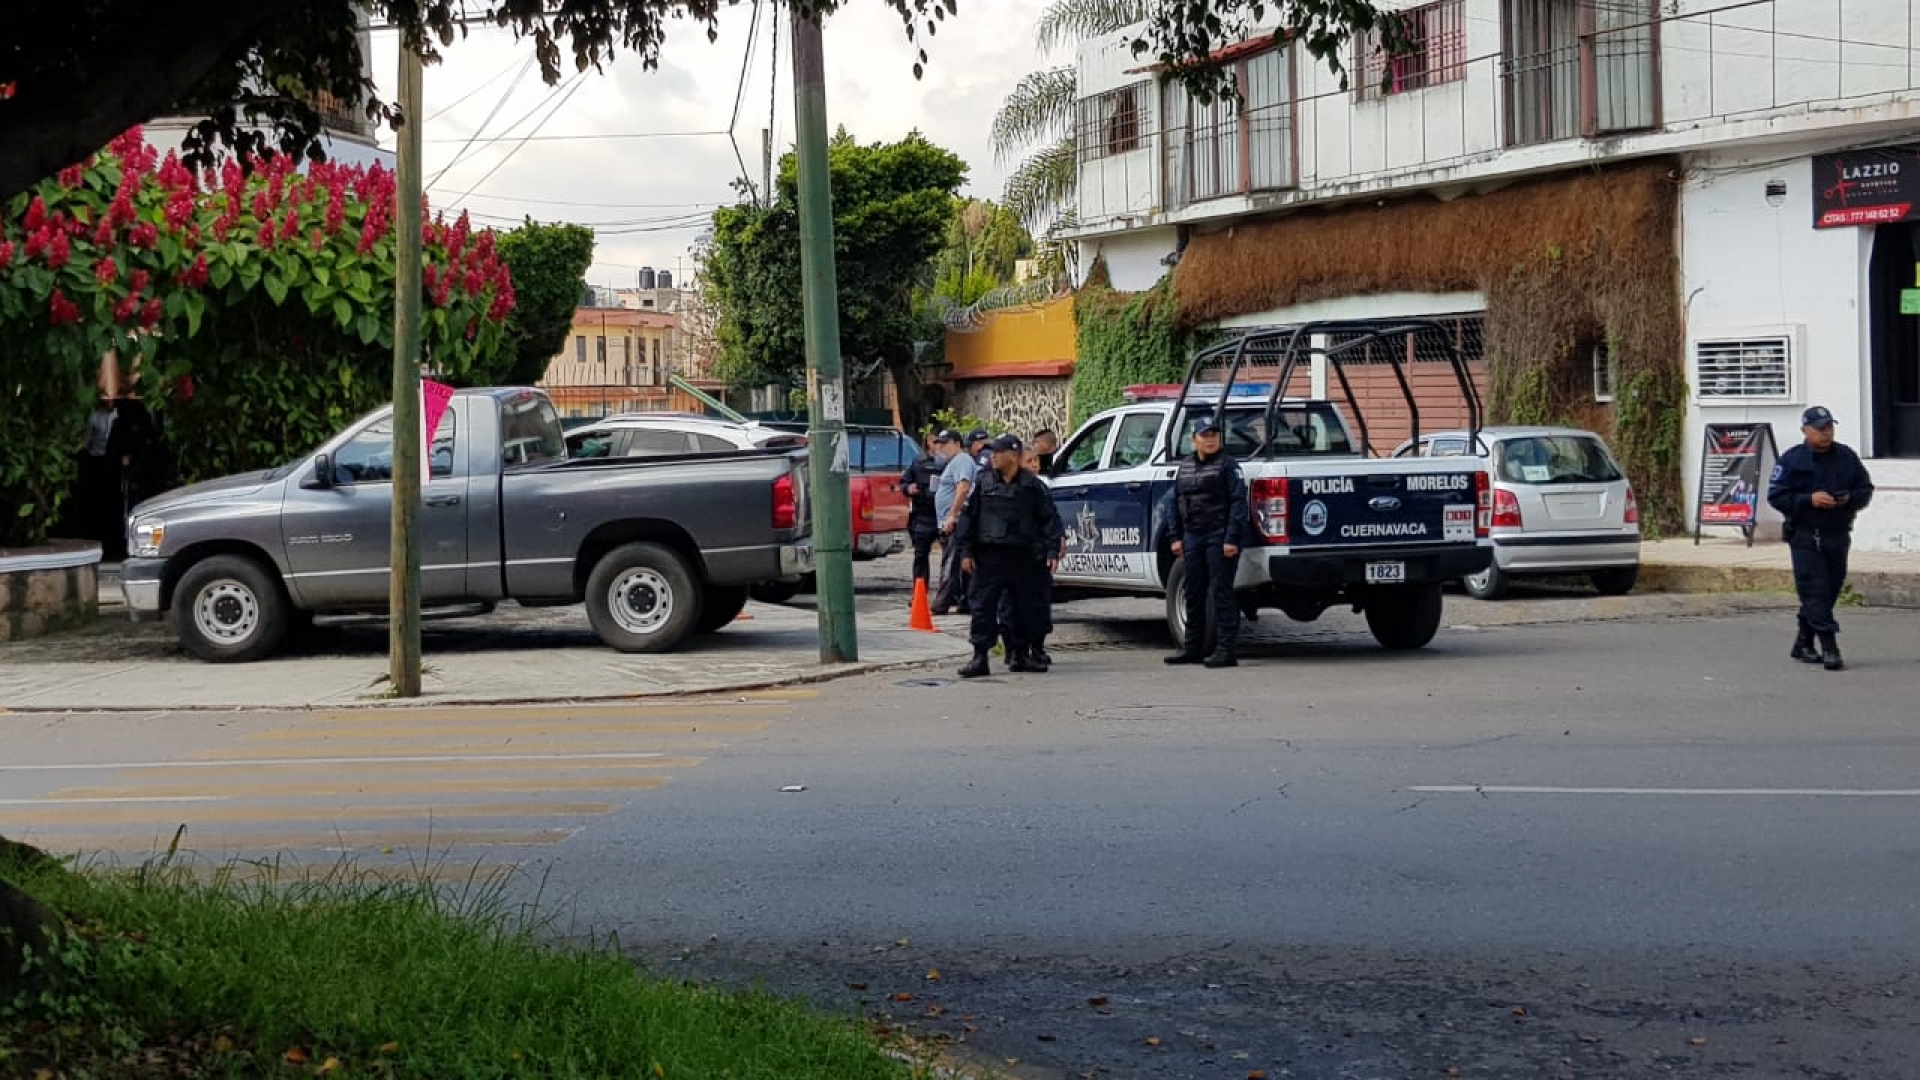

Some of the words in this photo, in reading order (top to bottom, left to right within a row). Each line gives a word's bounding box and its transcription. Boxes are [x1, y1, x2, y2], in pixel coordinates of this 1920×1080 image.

[1843, 162, 1900, 179] LAZZIO
[1302, 477, 1355, 495] POLICÍA
[1406, 475, 1468, 492] MORELOS
[1101, 527, 1140, 546] MORELOS
[1340, 522, 1428, 537] CUERNAVACA
[1369, 564, 1401, 579] 1823
